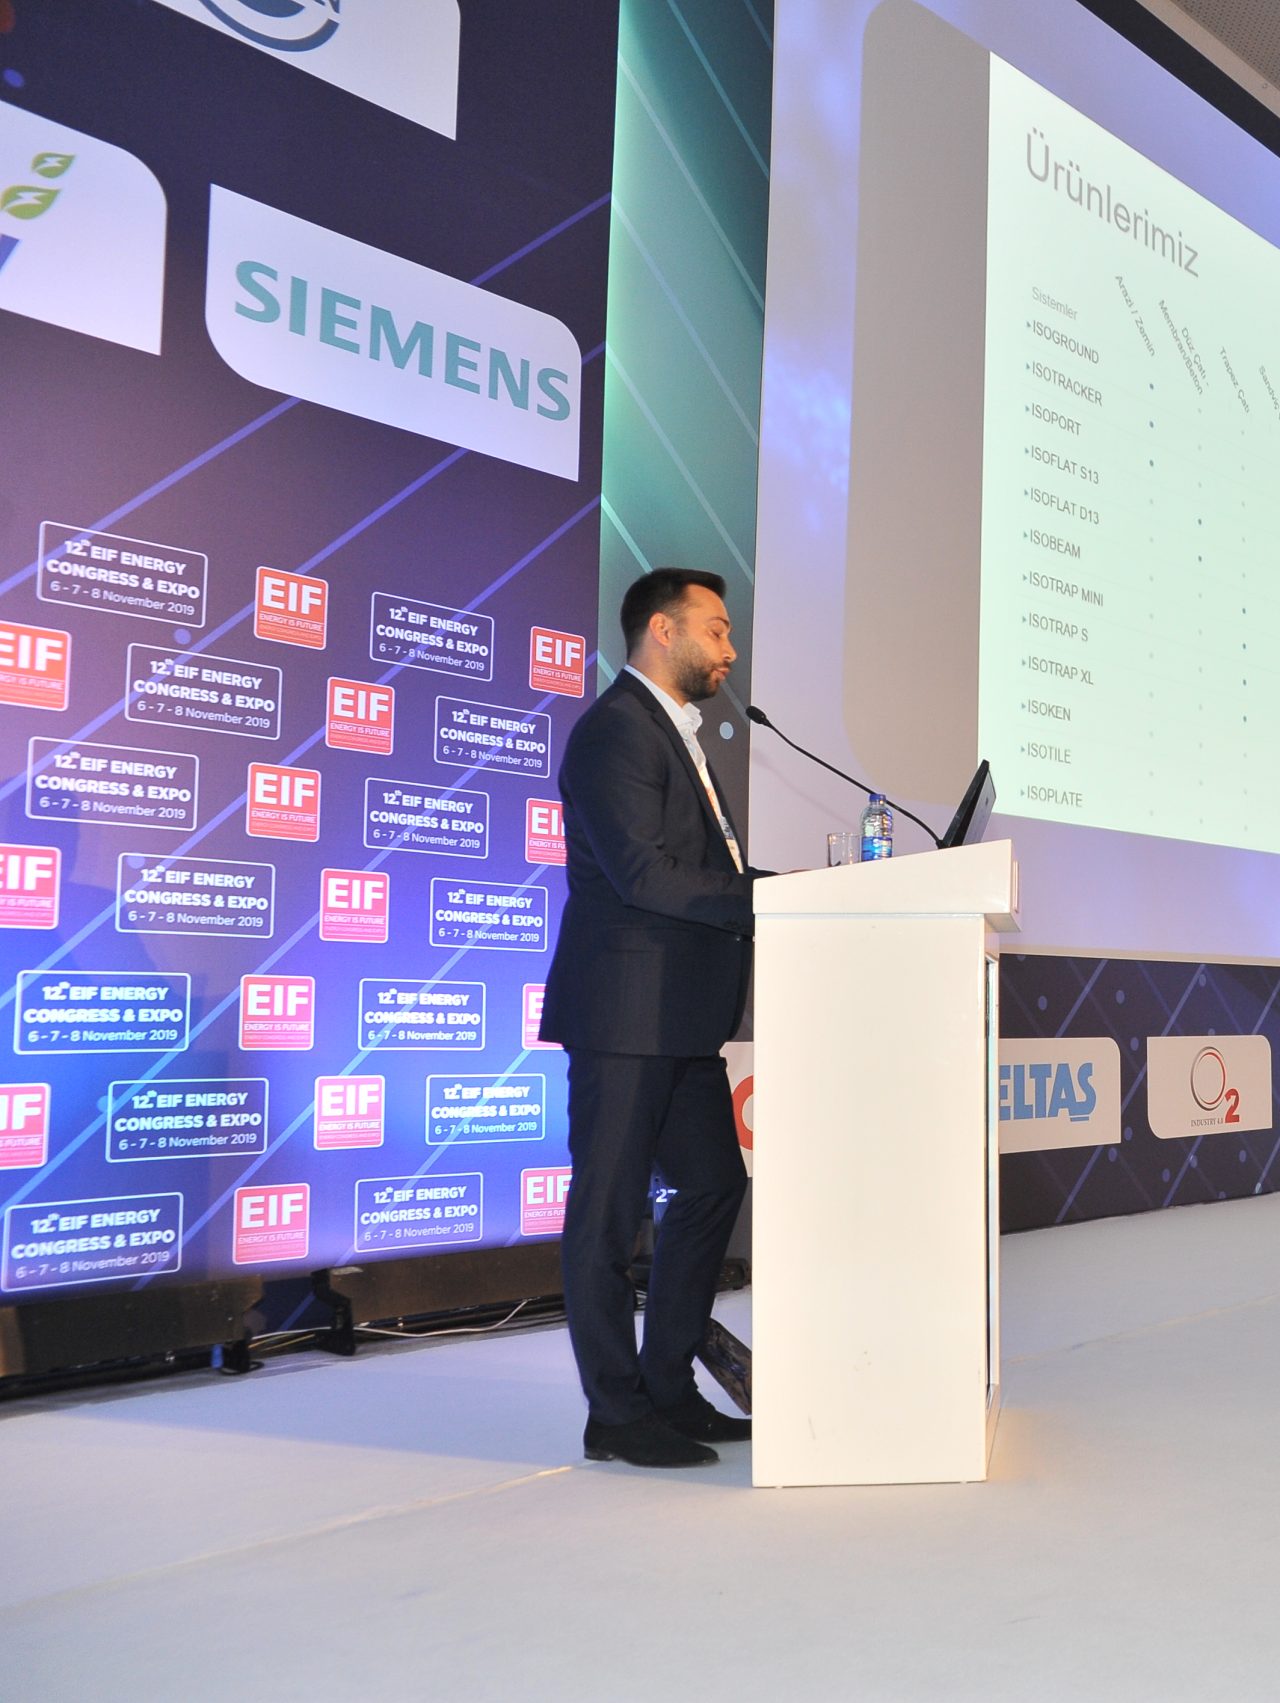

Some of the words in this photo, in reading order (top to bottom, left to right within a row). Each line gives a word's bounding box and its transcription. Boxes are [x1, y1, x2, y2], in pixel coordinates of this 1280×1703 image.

[1027, 127, 1199, 278] Ürünlerimiz
[1032, 286, 1077, 320] Sistemler
[1115, 275, 1134, 308] Arazi
[1135, 316, 1155, 357] Zemin
[234, 260, 571, 422] SIEMENS
[1032, 320, 1100, 364] ISOGROUND
[1181, 327, 1195, 352] Düz
[1219, 346, 1239, 388] Trapez
[1032, 360, 1103, 407] ISOTRACKER
[1031, 403, 1081, 436] ISOPORT
[1031, 445, 1077, 475] ISOFLAT
[1080, 466, 1099, 484] S13
[1030, 488, 1077, 516] ISOFLAT
[1079, 505, 1100, 525] D13
[1029, 529, 1081, 559] ISOBEAM
[90, 544, 118, 562] EIF
[120, 550, 186, 576] ENERGY
[46, 557, 139, 588] CONGRESS
[142, 576, 154, 590] &
[157, 579, 200, 599] EXPO
[1029, 571, 1078, 598] ISOTRAP
[1081, 587, 1104, 607] MINI
[262, 576, 321, 614] EIF
[407, 611, 427, 626] EIF
[429, 615, 478, 637] ENERGY
[1029, 612, 1078, 638] ISOTRAP
[1081, 628, 1088, 642] S
[376, 623, 443, 648] CONGRESS
[445, 637, 454, 650] &
[456, 640, 488, 657] EXPO
[535, 635, 580, 667] EIF
[174, 664, 199, 680] EIF
[201, 668, 262, 691] ENERGY
[534, 667, 554, 677] ENERGY
[561, 673, 581, 682] FUTURE
[1028, 656, 1078, 680] ISOTRAP
[1081, 669, 1094, 685] XL
[133, 679, 219, 704] CONGRESS
[222, 692, 232, 706] &
[235, 695, 275, 712] EXPO
[333, 686, 388, 721] EIF
[1028, 699, 1071, 721] ISOKEN
[331, 722, 355, 732] ENERGY
[365, 727, 389, 737] FUTURE
[470, 713, 488, 727] EIF
[490, 717, 535, 735] ENERGY
[440, 726, 504, 748] CONGRESS
[506, 737, 513, 749] &
[516, 739, 546, 754] EXPO
[1027, 742, 1071, 764] ISOTILE
[79, 756, 107, 772] EIF
[110, 759, 177, 780] ENERGY
[34, 774, 130, 796] CONGRESS
[133, 784, 144, 797] &
[148, 785, 191, 802] EXPO
[254, 772, 314, 807] EIF
[1027, 785, 1083, 808] ISOPLATE
[401, 794, 421, 808] EIF
[423, 797, 473, 814] ENERGY
[369, 810, 438, 829] CONGRESS
[440, 818, 449, 830] &
[451, 819, 484, 834] EXPO
[373, 829, 380, 839] 6
[388, 831, 394, 840] 7
[403, 832, 409, 842] 8
[411, 833, 457, 846] November
[459, 838, 480, 849] 2019
[164, 870, 190, 884] EIF
[192, 871, 255, 889] ENERGY
[327, 877, 383, 909] EIF
[123, 889, 211, 907] CONGRESS
[213, 894, 224, 907] &
[228, 895, 269, 910] EXPO
[247, 984, 308, 1015] EIF
[156, 1093, 183, 1107] EIF
[185, 1091, 248, 1106] ENERGY
[321, 1084, 378, 1115] EIF
[114, 1114, 204, 1131] CONGRESS
[207, 1113, 218, 1126] &
[221, 1112, 262, 1126] EXPO
[319, 1123, 345, 1131] ENERGY
[1190, 1118, 1216, 1127] INDUSTRY
[393, 1189, 413, 1202] EIF
[416, 1185, 466, 1200] ENERGY
[527, 1175, 572, 1204] EIF
[241, 1193, 303, 1228] EIF
[360, 1207, 431, 1224] CONGRESS
[433, 1206, 442, 1218] &
[444, 1203, 478, 1217] EXPO
